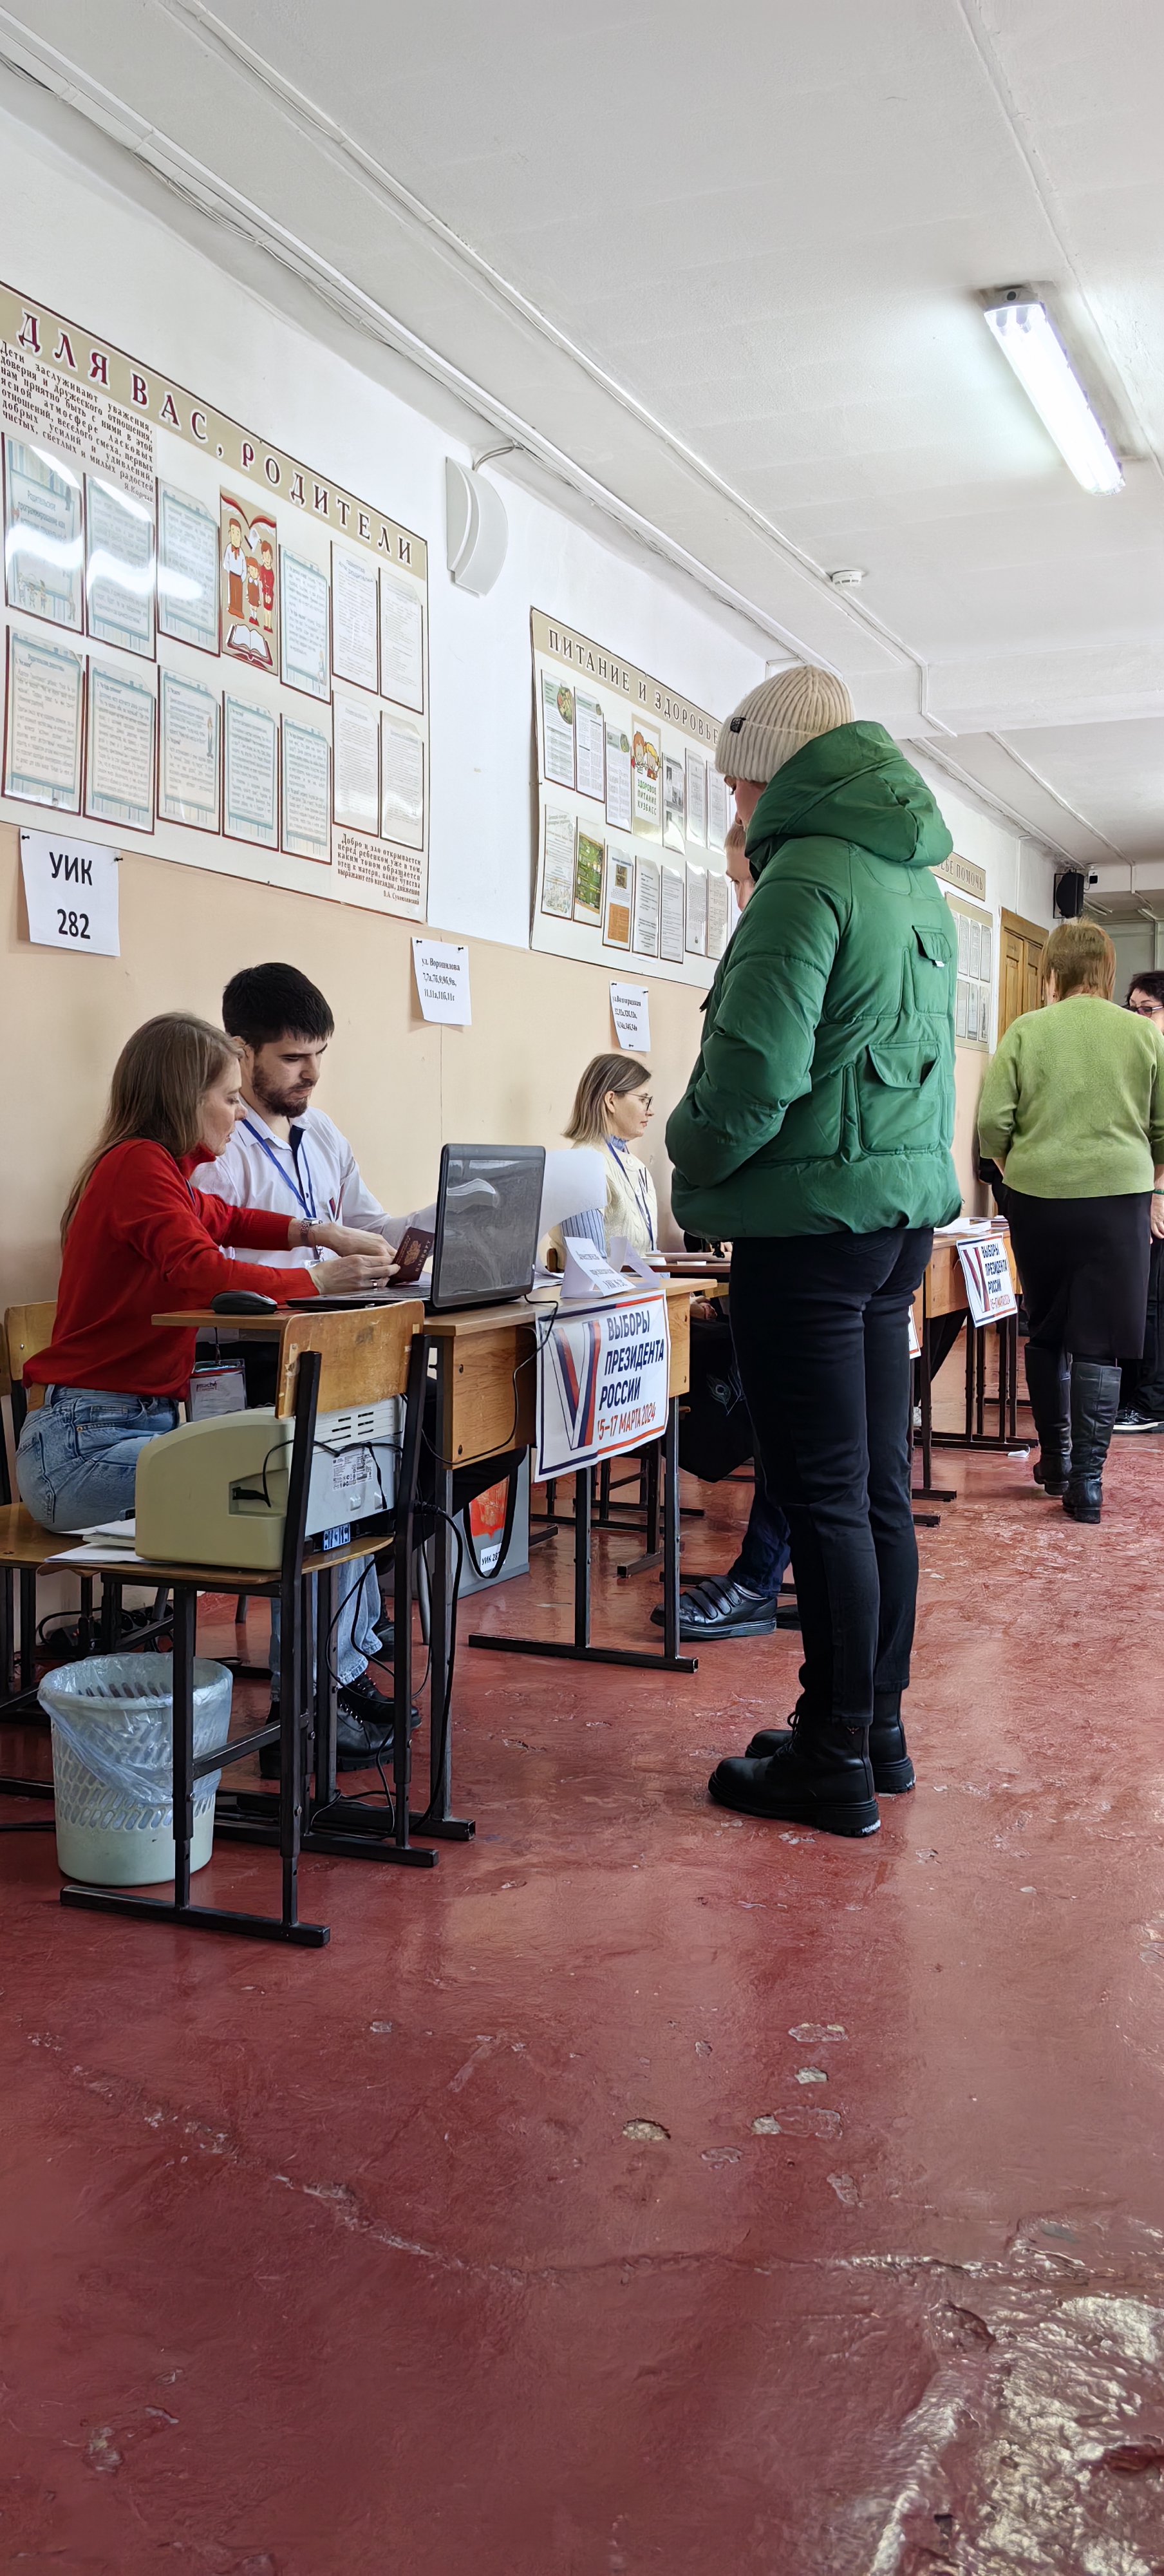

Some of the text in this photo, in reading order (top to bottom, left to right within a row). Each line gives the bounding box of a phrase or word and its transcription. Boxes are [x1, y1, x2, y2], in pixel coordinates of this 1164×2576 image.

[1, 356, 37, 381] доверия
[43, 378, 48, 386] и
[54, 385, 102, 415] дружеского
[1, 341, 153, 435] Дети заслуживают уважения,
[1, 366, 17, 381] нам
[24, 378, 59, 403] приятно
[66, 399, 86, 417] быть
[101, 420, 122, 437] ними
[136, 438, 153, 453] этой
[1, 377, 153, 463] ясной атмосфере ласковых
[3, 399, 39, 424] добрых
[50, 423, 81, 446] усилий
[91, 445, 96, 453] и
[1, 388, 153, 473] отношений, веселого смеха, первых
[18, 311, 109, 386] ДЛЯ
[131, 372, 223, 457] ВАС,
[241, 442, 412, 565] РОДИТЕЛИ
[42, 431, 77, 454] светлых
[90, 455, 116, 473] милых
[120, 469, 153, 493] радостей
[549, 629, 718, 745] ПИТАНИЕ И ЗДОРОВЬЕ
[637, 789, 657, 806] ПИТАНИЕ
[337, 843, 356, 855] перед
[359, 849, 388, 863] ребенком
[337, 860, 351, 871] отец
[337, 851, 420, 881] каким тоном обращается
[341, 833, 362, 849] Добро
[383, 849, 421, 866] открывается
[49, 851, 93, 886] УИК
[956, 864, 983, 891] ПОМОЧЬ
[57, 908, 91, 940] 282
[606, 1310, 650, 1341] ВЫБОРЫ
[604, 1338, 665, 1376] ПРЕЗИДЕНТА
[598, 1376, 641, 1411] РОССИИ
[619, 1406, 641, 1435] МАРТА
[641, 1402, 656, 1426] 2024
